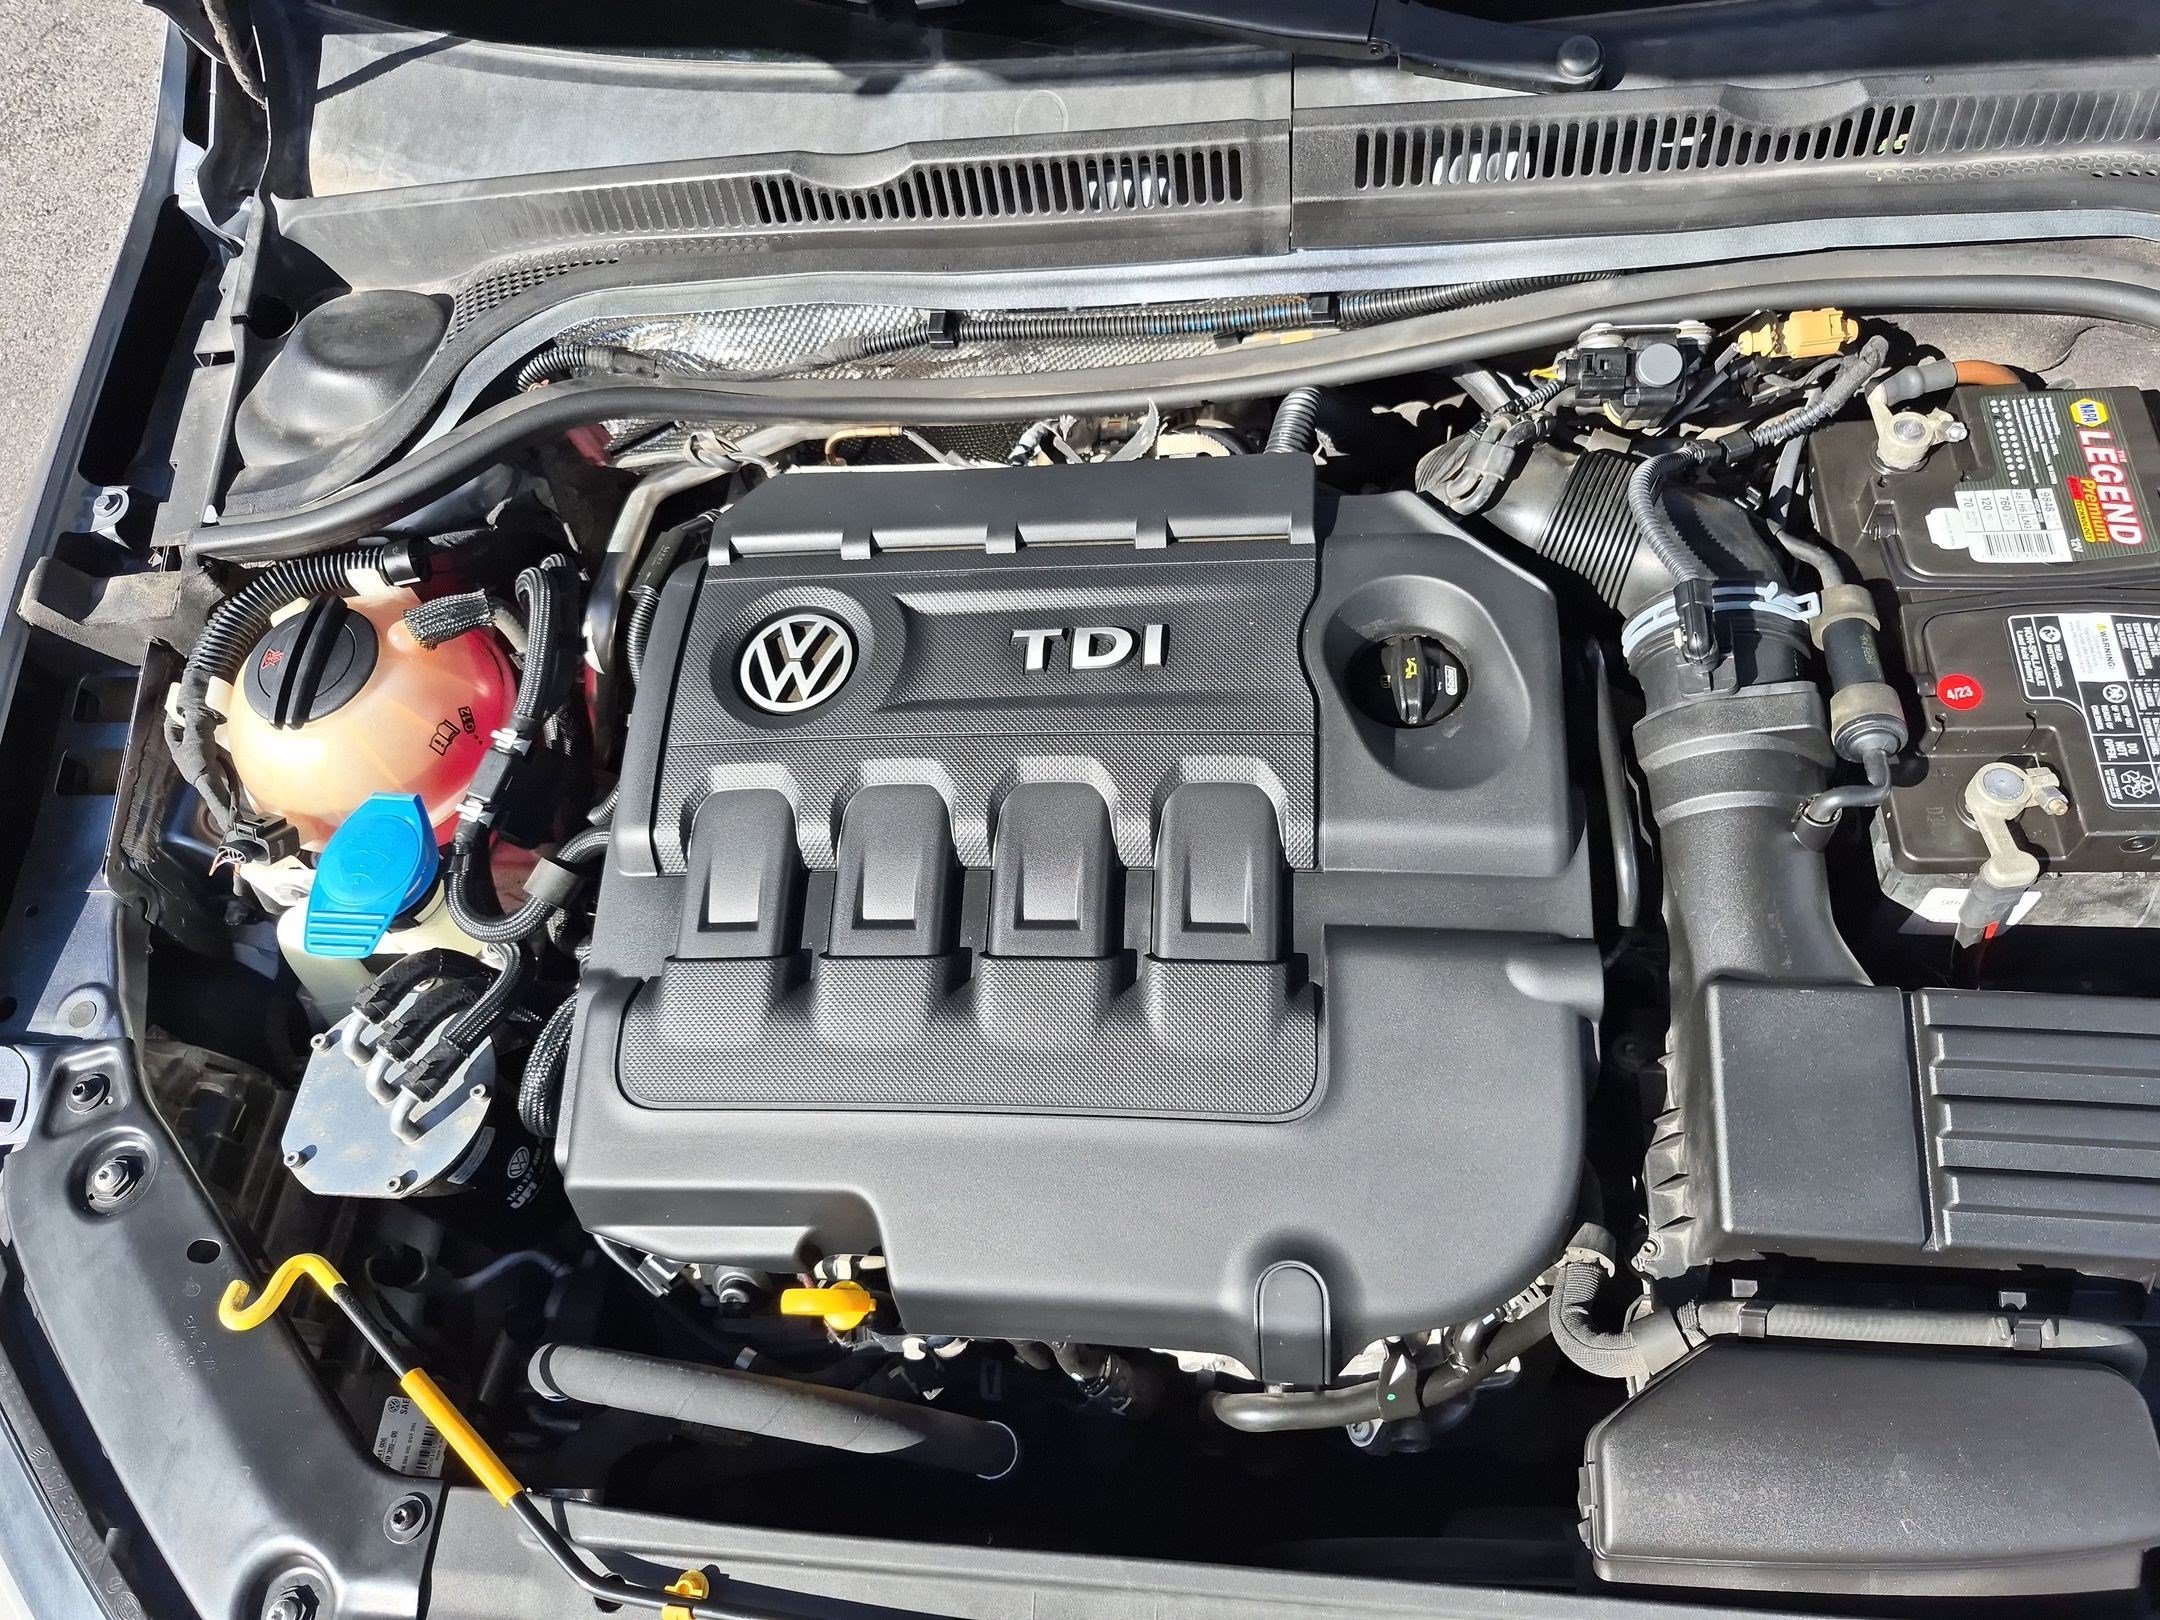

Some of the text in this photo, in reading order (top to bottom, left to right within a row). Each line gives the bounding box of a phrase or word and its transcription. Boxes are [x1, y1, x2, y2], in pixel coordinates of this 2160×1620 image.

[2080, 404, 2098, 422] NAPA
[2080, 431, 2142, 545] LEGEND
[1963, 498, 1974, 507] 70
[1981, 497, 1992, 510] 120
[2000, 496, 2011, 511] 760
[2040, 492, 2054, 512] 9848
[2080, 480, 2108, 541] Premium
[2075, 501, 2093, 540] TECHNOLOGY
[2071, 538, 2083, 552] 12V
[1010, 623, 1165, 674] TDI
[2016, 631, 2035, 683] Lead Acid Battery
[2023, 627, 2046, 686] NON-SPILLABLE
[2053, 644, 2063, 661] READ
[2100, 631, 2115, 669] WARNING:
[2045, 644, 2063, 688] INSTRUCTIONS.
[1946, 685, 1973, 701] 4/23
[2125, 718, 2134, 728] OUT
[2103, 738, 2116, 761] OPEN.
[2114, 741, 2128, 757] NOT
[2126, 743, 2139, 754] DO
[510, 1181, 537, 1209] UFI
